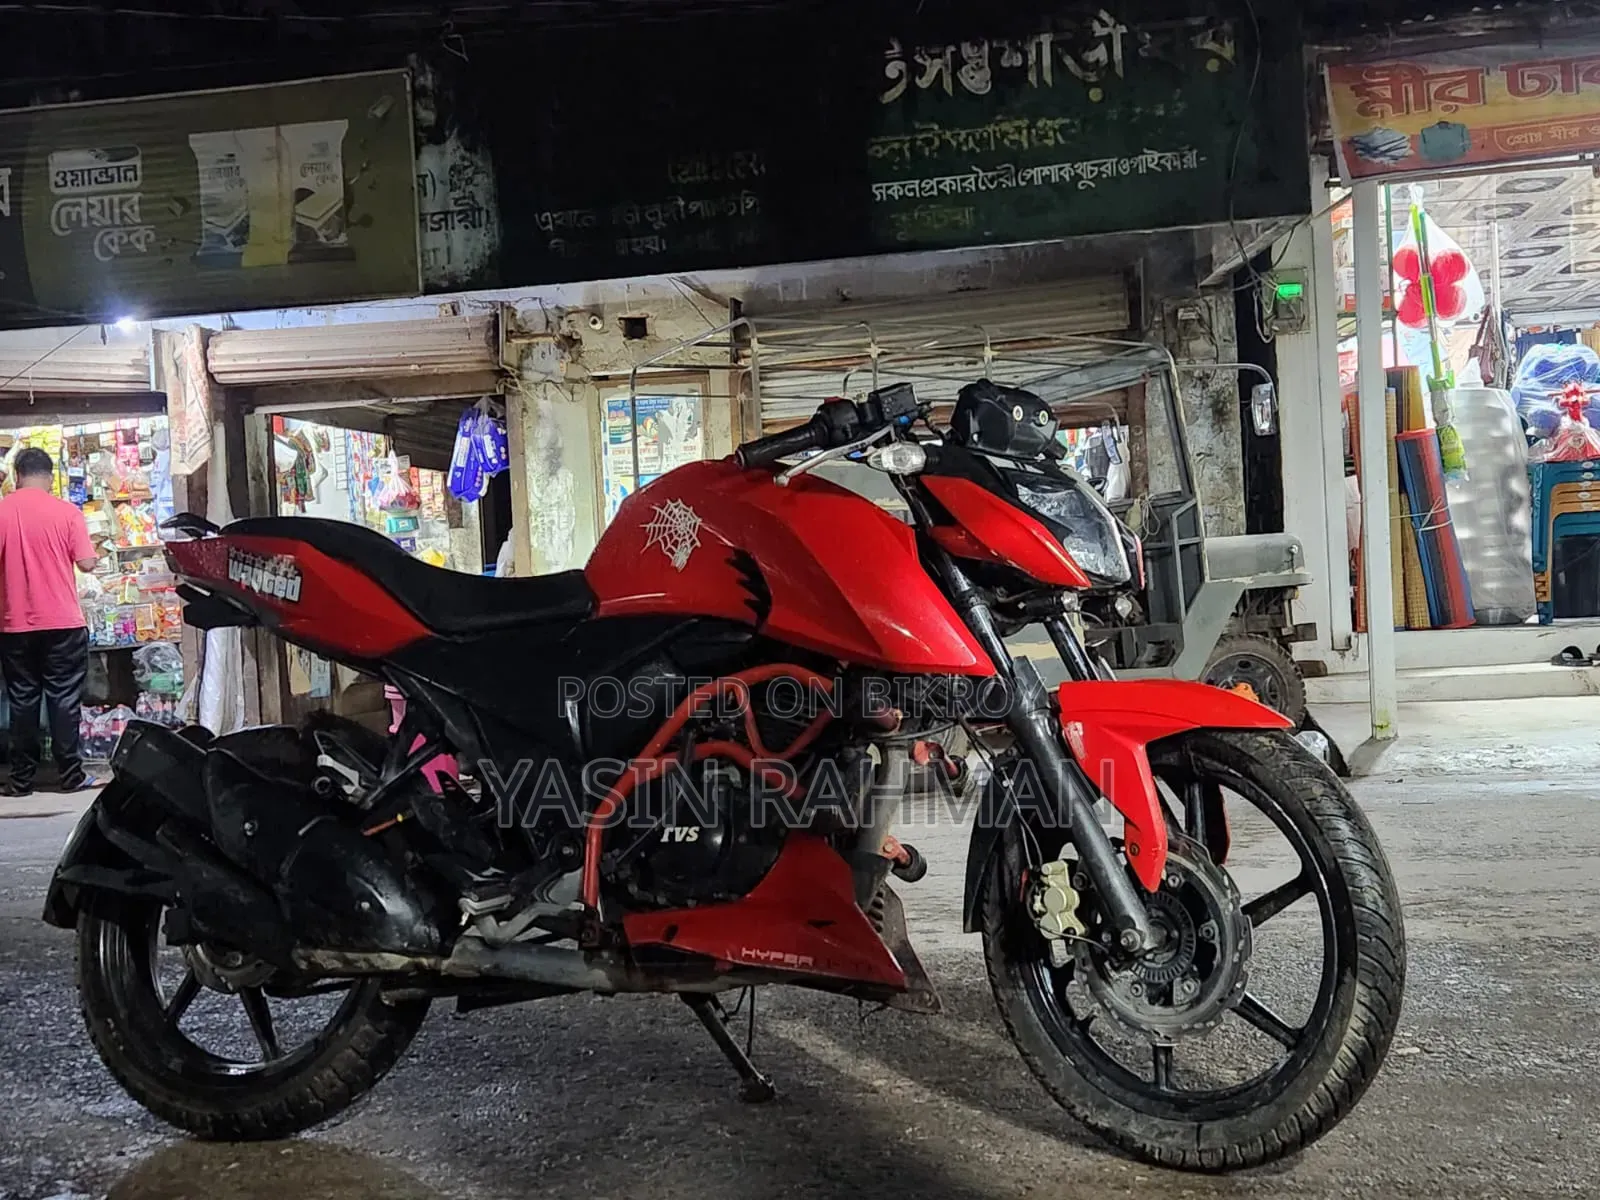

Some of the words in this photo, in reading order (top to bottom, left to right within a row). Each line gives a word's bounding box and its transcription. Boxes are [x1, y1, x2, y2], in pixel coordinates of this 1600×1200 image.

[51, 192, 144, 237] লেয়ার
[93, 224, 156, 261] কেক
[741, 946, 815, 968] HYPER
